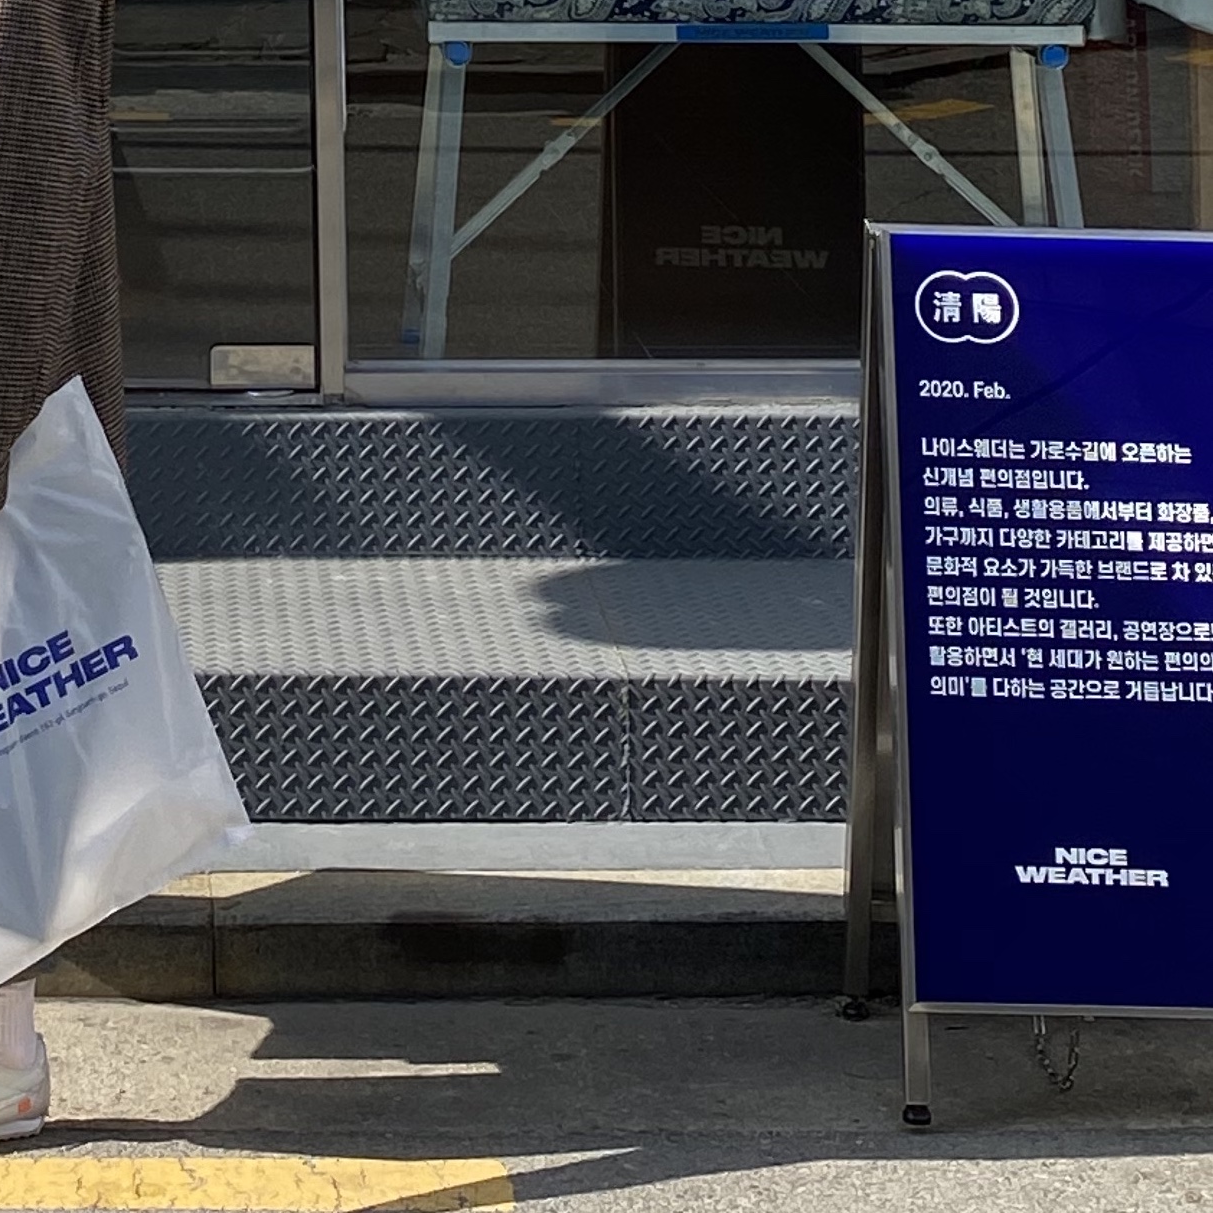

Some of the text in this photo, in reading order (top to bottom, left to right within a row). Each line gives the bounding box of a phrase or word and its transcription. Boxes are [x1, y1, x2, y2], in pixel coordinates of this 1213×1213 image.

[919, 379, 1012, 399] 2020. Feb.
[921, 437, 1192, 464] 나이스웨더는 가로수길에 오픈하는
[923, 467, 1090, 490] 신개념 편의점입니다.
[923, 496, 964, 518] 의류,
[969, 497, 1009, 519] 식품,
[1013, 499, 1153, 522] 생활용품에서부터
[925, 526, 994, 547] 가구까지
[999, 527, 1052, 549] 다양한
[1056, 529, 1144, 551] 카테고리를
[927, 555, 978, 578] 문화적
[983, 557, 1037, 578] 요소가
[1040, 558, 1093, 580] 가득한
[1097, 560, 1168, 581] 브랜드로
[1171, 561, 1191, 582] 차
[927, 585, 1100, 609] 편의점이 될 것입니다.
[928, 616, 1213, 641] 또한 아티스트의 갤러리, 공연장으로
[929, 646, 1016, 667] 활용하면서
[1048, 648, 1102, 670] 세대가
[1107, 650, 1159, 671] 원하는
[993, 677, 1046, 699] 다하는
[1050, 679, 1121, 699] 공간으로
[1055, 847, 1128, 866] NICE
[1015, 865, 1169, 887] WEATHER
